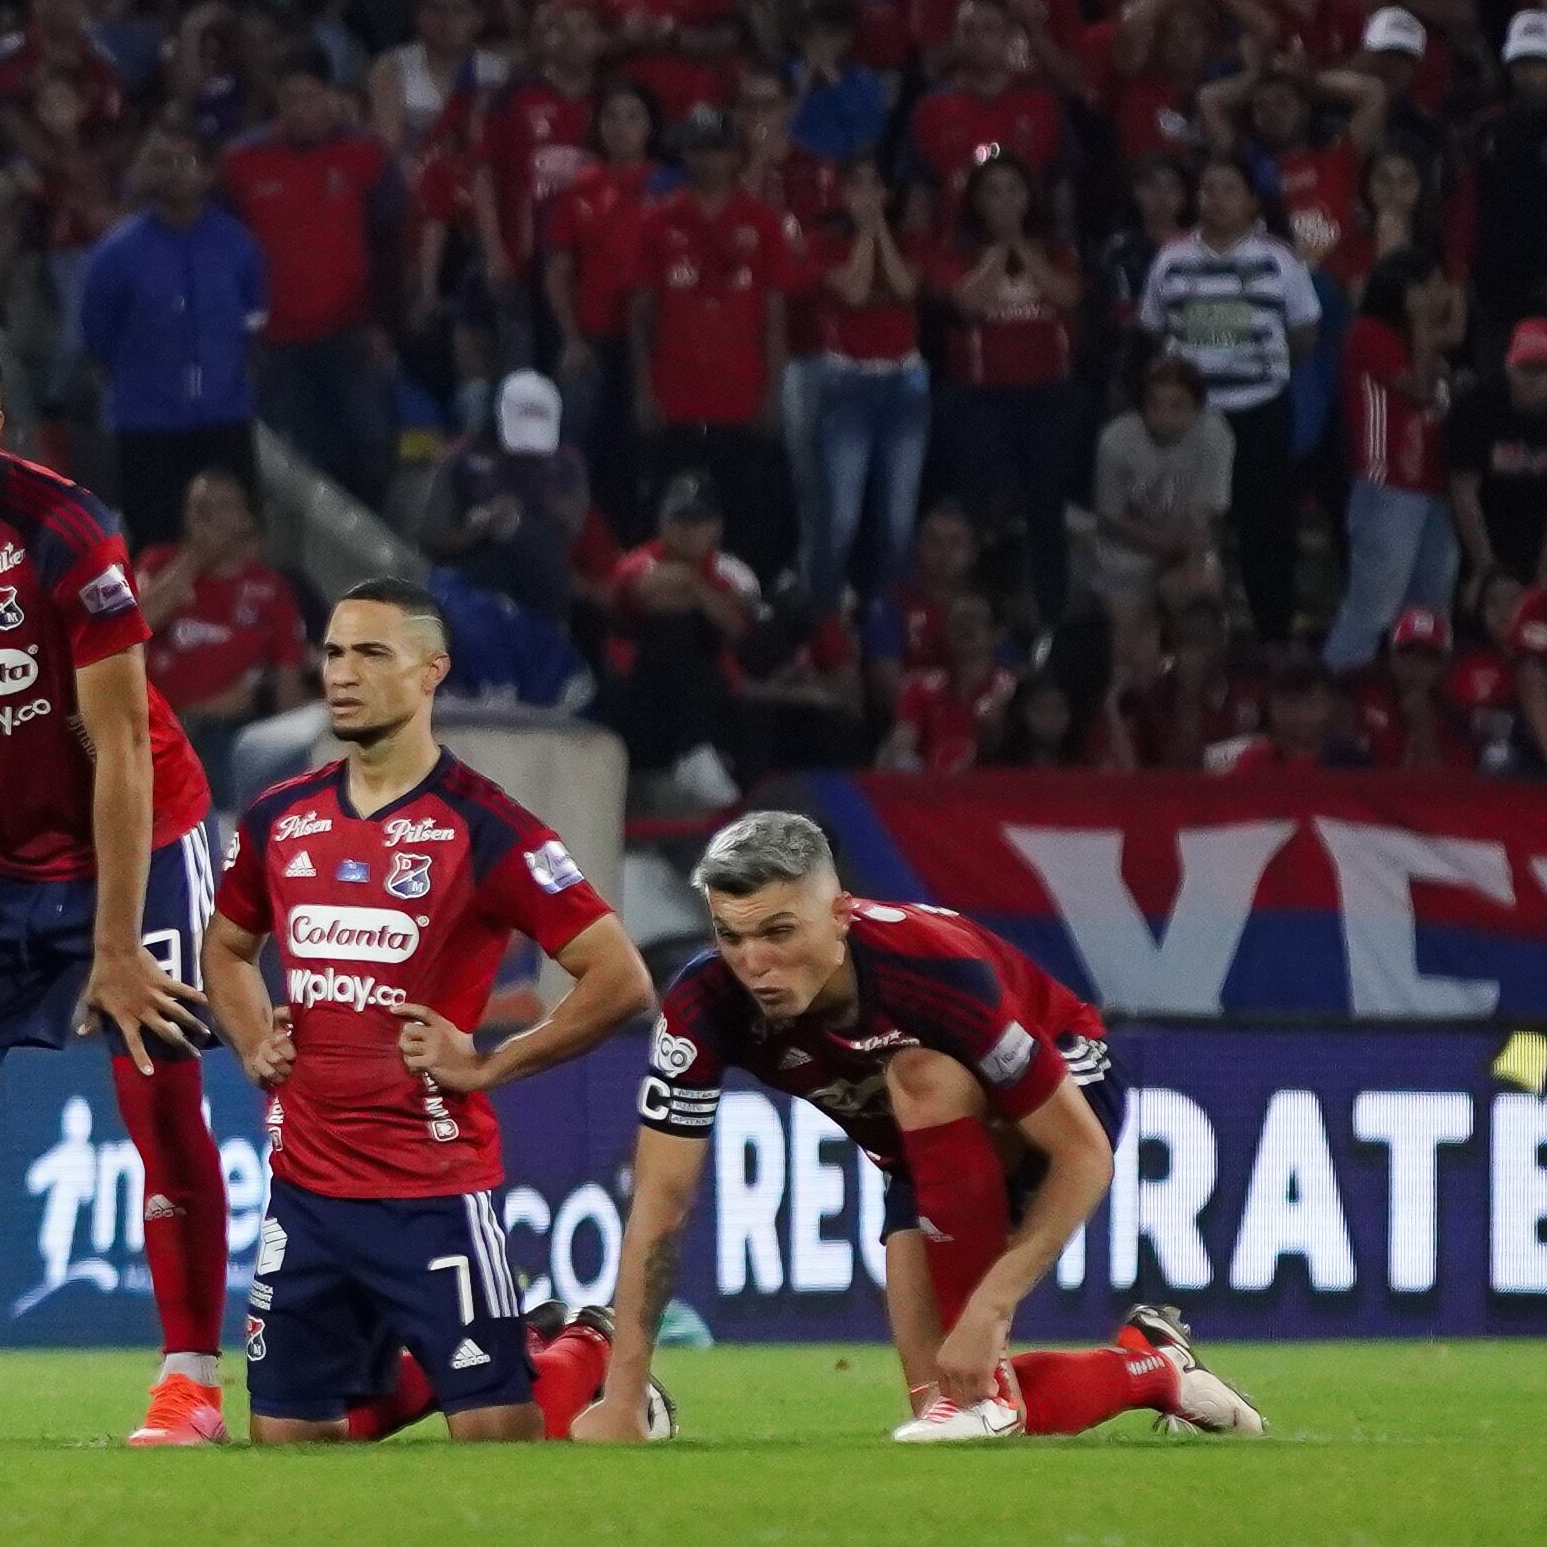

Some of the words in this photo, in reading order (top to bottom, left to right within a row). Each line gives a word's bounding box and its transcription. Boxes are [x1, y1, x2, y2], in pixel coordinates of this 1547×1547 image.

[273, 813, 333, 843] Pilsen
[383, 817, 455, 848] Pilsen
[291, 914, 413, 951] Colanta
[642, 1076, 671, 1121] C
[428, 1255, 475, 1326] 7
